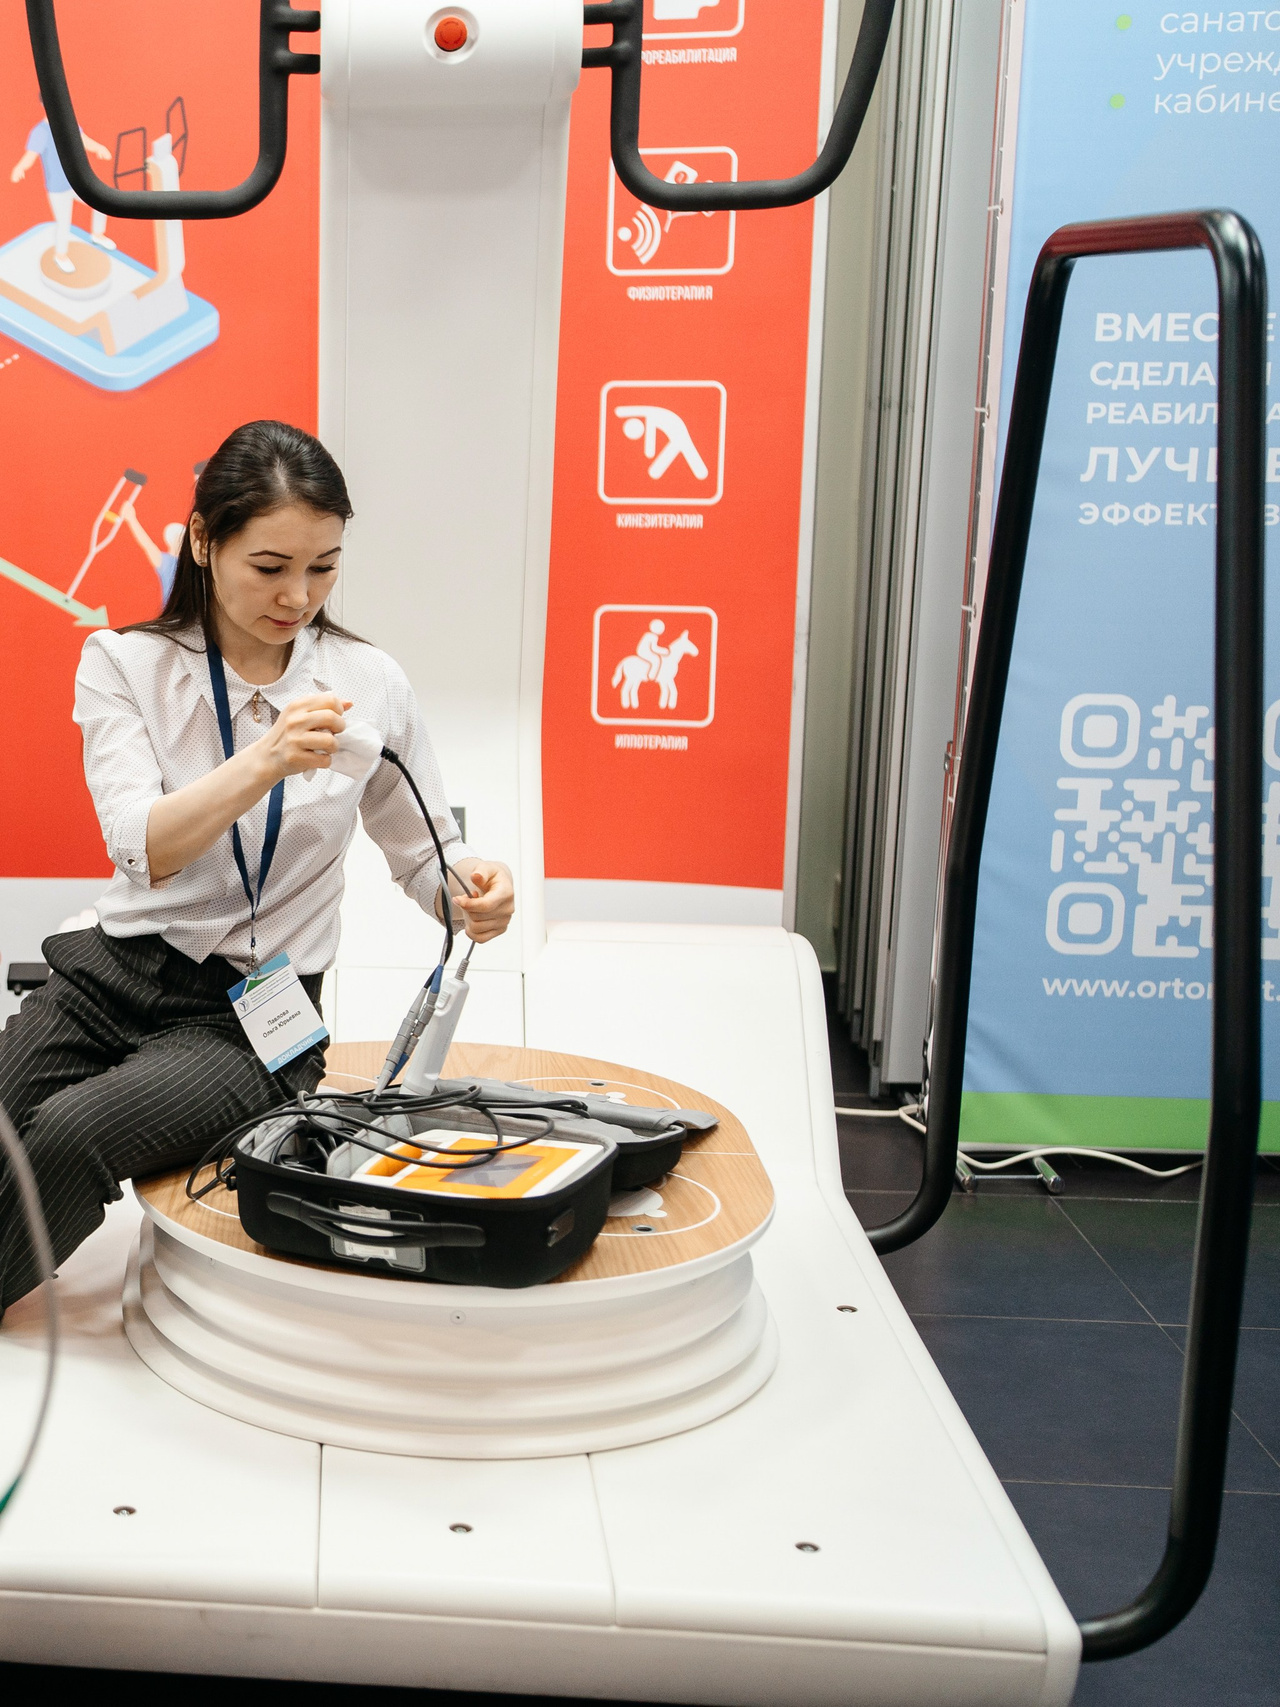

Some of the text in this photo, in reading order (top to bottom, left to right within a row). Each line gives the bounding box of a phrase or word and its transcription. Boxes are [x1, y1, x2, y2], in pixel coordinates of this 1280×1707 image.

[627, 285, 713, 301] ФИЗИОТЕРАПИЯ
[1095, 312, 1277, 342] ВМЕС
[1089, 361, 1271, 391] СДЕЛА
[1086, 402, 1280, 425] РЕАБИЛА
[1079, 446, 1280, 483] ЛУЧЕ
[616, 513, 703, 529] КИНЕЗИТЕРАПИЯ
[1078, 502, 1280, 526] ЭФФЕКВ
[615, 734, 688, 751] ИППОТЕРАПИЯ
[262, 1010, 301, 1038] Ольга Юрьевна
[267, 1009, 289, 1026] Павлова
[277, 1035, 314, 1065] ДОКЛАДЧИК
